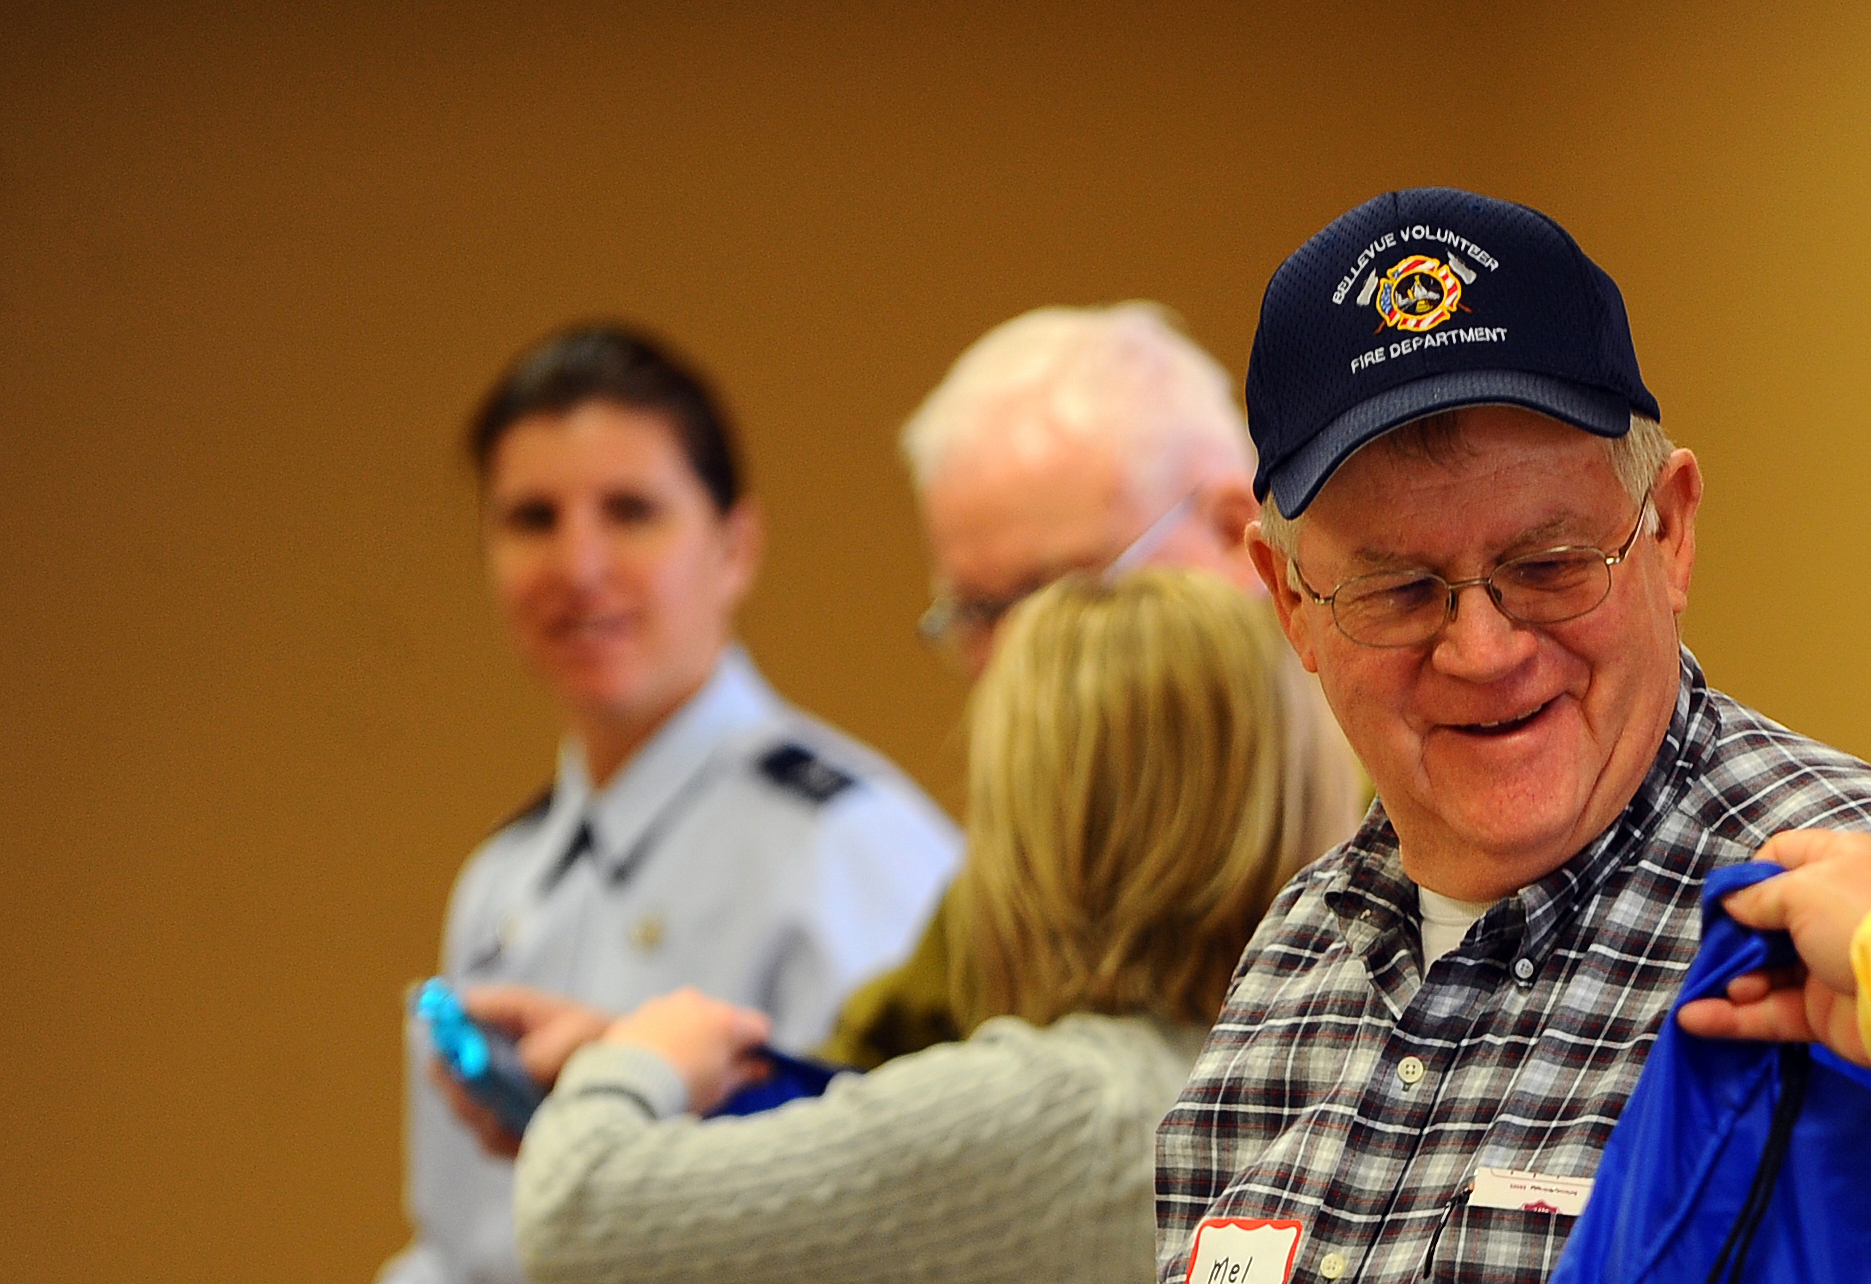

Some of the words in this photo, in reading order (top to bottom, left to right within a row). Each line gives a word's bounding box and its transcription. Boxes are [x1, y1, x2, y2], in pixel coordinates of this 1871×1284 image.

[1332, 232, 1397, 305] BELLEVUE
[1400, 224, 1500, 272] VOLUNTEER
[1350, 346, 1386, 375] FIRE
[1389, 326, 1508, 360] DEPARTMENT
